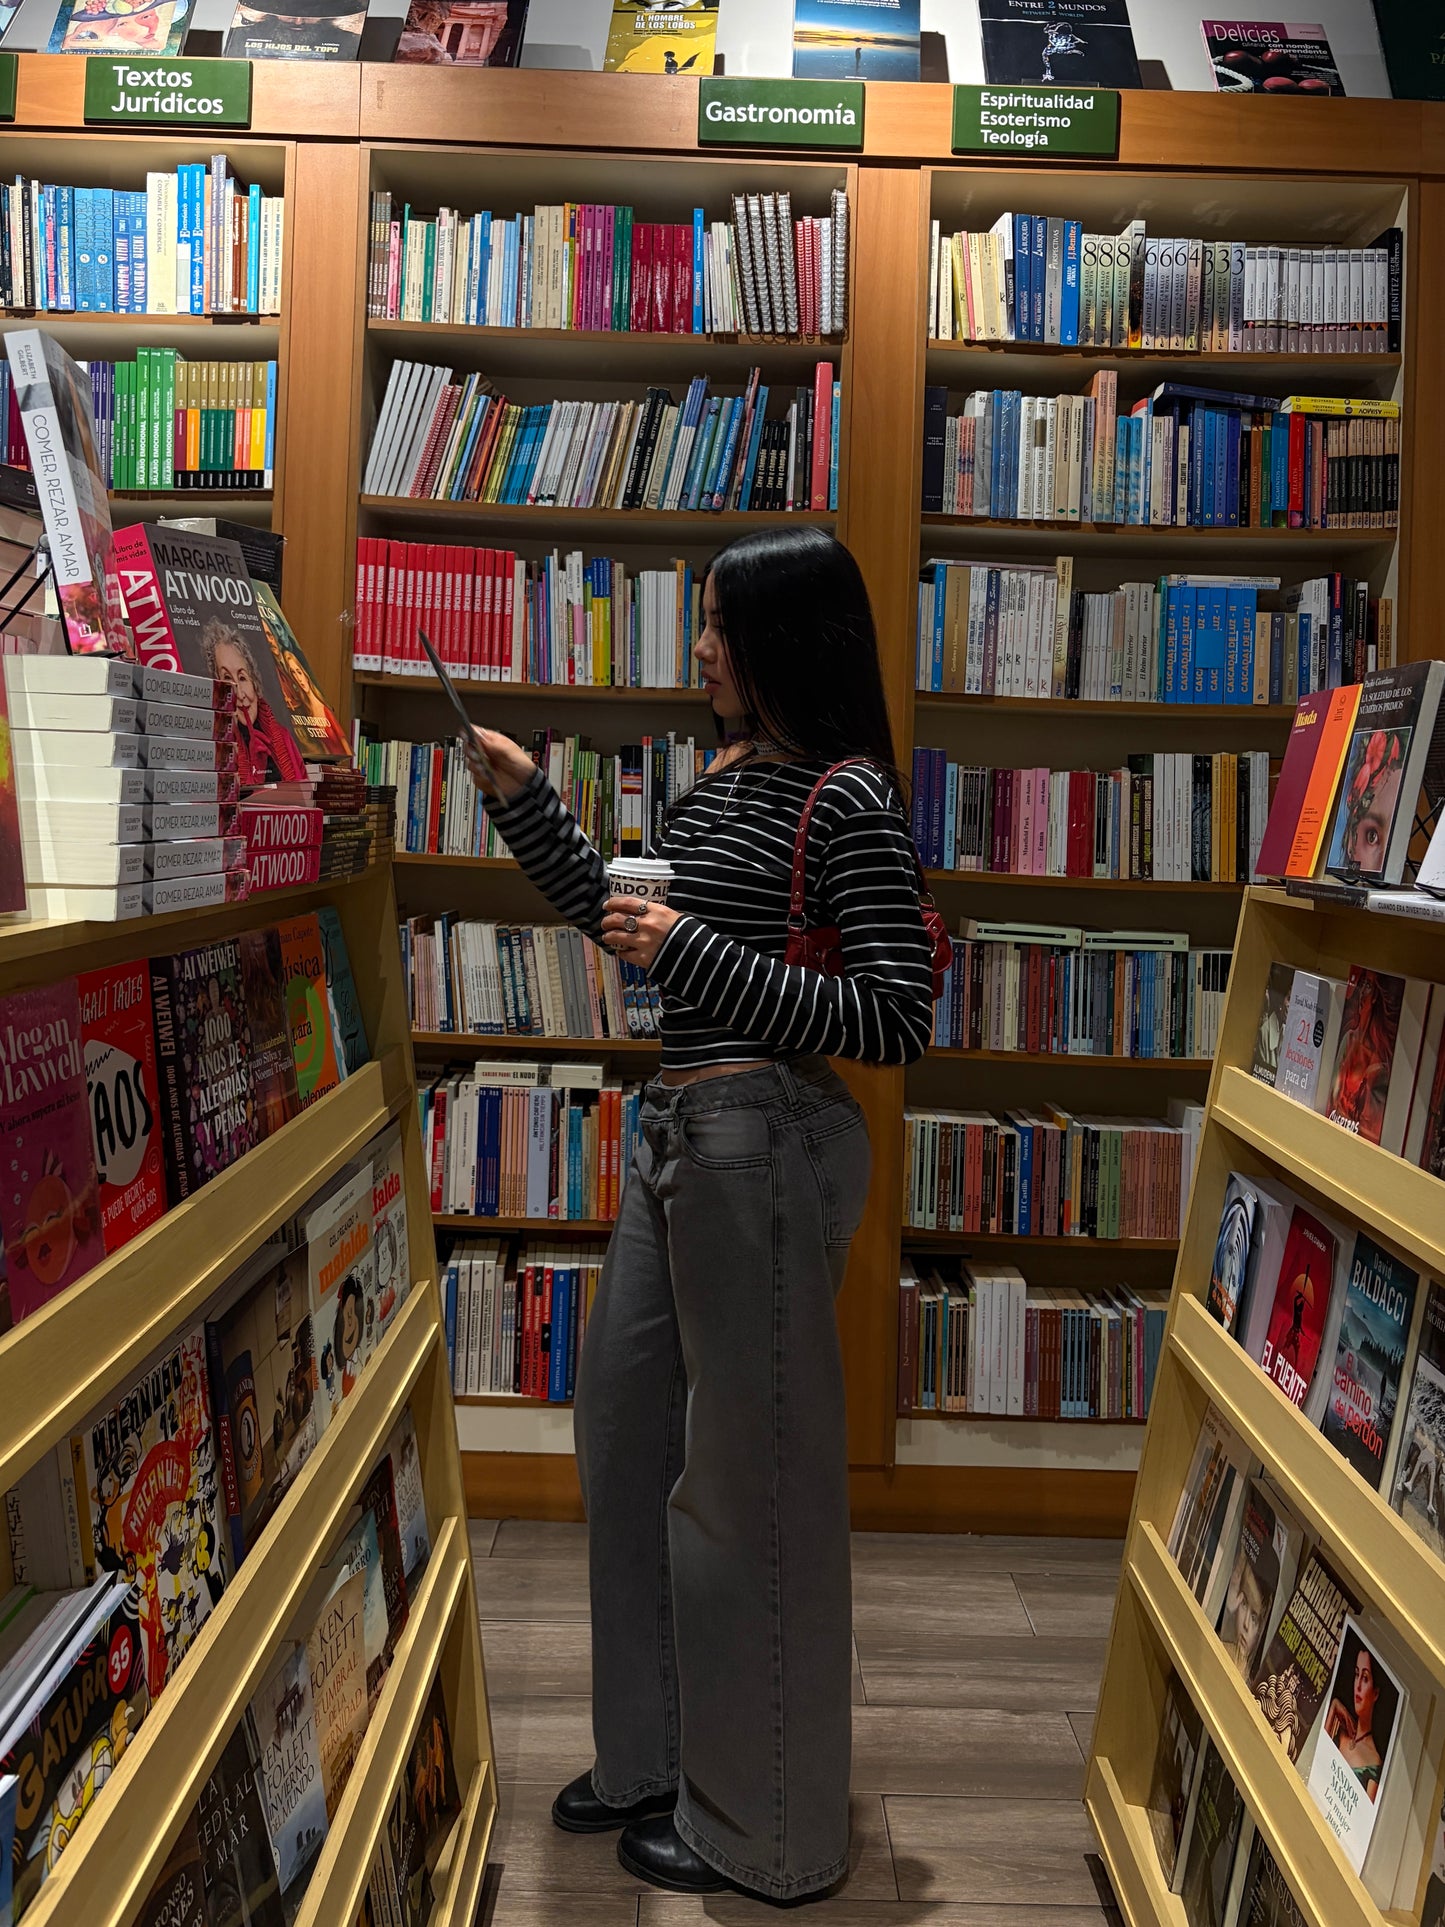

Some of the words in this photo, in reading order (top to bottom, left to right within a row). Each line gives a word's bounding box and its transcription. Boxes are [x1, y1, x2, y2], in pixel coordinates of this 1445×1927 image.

[1008, 0, 1045, 9] ENTRE
[1048, 0, 1056, 9] 2
[1058, 3, 1107, 12] MUNDOS
[1213, 24, 1280, 43] Delicias
[113, 66, 193, 87] Textos
[111, 91, 224, 115] Jurídicos
[705, 101, 856, 126] Gastronomía
[980, 92, 1094, 111] Espiritualidad
[980, 111, 1071, 129] Esoterismo
[980, 129, 1048, 147] Teología
[1083, 241, 1097, 266] 8
[1099, 242, 1113, 267] 8
[1117, 242, 1130, 267] 8
[1134, 233, 1144, 255] 7
[1145, 245, 1157, 265] 6
[1160, 247, 1172, 267] 6
[1175, 246, 1187, 266] 6
[1189, 247, 1200, 267] 4
[1215, 249, 1230, 274] 3
[1231, 249, 1244, 275] 3
[17, 349, 29, 377] GILBERT
[24, 344, 37, 380] ELIZABETH
[58, 532, 80, 577] AMAR
[114, 544, 133, 555] Libro
[134, 540, 143, 549] de
[116, 555, 128, 563] mis
[129, 550, 147, 560] vidas
[153, 543, 243, 576] MARGARET
[165, 570, 253, 607] ATWOOD
[169, 605, 185, 615] Libro
[173, 617, 184, 625] mis
[184, 618, 200, 627] vidas
[231, 610, 247, 620] Como
[247, 613, 259, 621] unas
[237, 622, 262, 632] memorias
[1166, 648, 1174, 692] CASCADAS
[1180, 648, 1188, 691] CASCADAS
[194, 687, 211, 699] AMAR
[1361, 693, 1369, 703] LA
[1369, 690, 1392, 702] SOLEDAD
[1393, 688, 1401, 697] DE
[1401, 686, 1413, 696] LOS
[1383, 700, 1404, 712] PRIMOS
[200, 782, 216, 794] AMAR
[200, 815, 217, 828] AMAR
[251, 814, 308, 848] ATWOOD
[203, 850, 221, 862] AMAR
[249, 851, 305, 889] ATWOOD
[205, 883, 223, 896] AMAR
[1378, 902, 1396, 911] CUANDO
[1396, 904, 1405, 912] ERA
[1406, 905, 1430, 915] DIVERTIDO
[183, 956, 197, 981] AI
[199, 945, 237, 979] WEIWEI
[112, 974, 143, 1011] TAJES
[152, 975, 168, 991] AI
[79, 979, 108, 1025] GALÍ
[154, 992, 177, 1058] WEIWEI
[204, 1012, 232, 1043] 1000
[507, 1018, 516, 1028] La
[1297, 1019, 1311, 1045] 21
[198, 1046, 227, 1082] AÑOS
[228, 1040, 243, 1065] DE
[1285, 1043, 1314, 1071] lecciones
[519, 1072, 535, 1080] NUDO
[1284, 1068, 1300, 1085] para
[1300, 1074, 1308, 1089] el
[199, 1067, 249, 1116] ALEGRÍAS
[203, 1120, 212, 1146] Y
[213, 1100, 248, 1141] PENAS
[373, 1173, 400, 1217] falda
[319, 1223, 369, 1295] mafalda
[1373, 1252, 1393, 1281] David
[1352, 1259, 1408, 1326] BALDACCI
[1261, 1339, 1273, 1374] EL
[1334, 1366, 1372, 1418] camino
[92, 1347, 181, 1470] MACANUDO
[1344, 1402, 1384, 1460] perdón
[129, 1457, 184, 1539] MACANUDO
[319, 1600, 345, 1653] KEN
[1279, 1614, 1300, 1653] EMILY
[111, 1637, 131, 1683] 35
[310, 1612, 359, 1699] FOLLETT
[322, 1659, 359, 1713] UMBRAL
[267, 1718, 312, 1792] FOLLETT
[268, 1754, 309, 1820] INVIERNO
[282, 1769, 315, 1818] MUNDO
[1330, 1758, 1360, 1808] SÁNDOR
[1330, 1777, 1354, 1816] MÁRAI
[1323, 1788, 1334, 1806] La
[1332, 1801, 1352, 1834] mujer
[216, 1809, 250, 1870] MAR
[1324, 1812, 1342, 1839] justa
